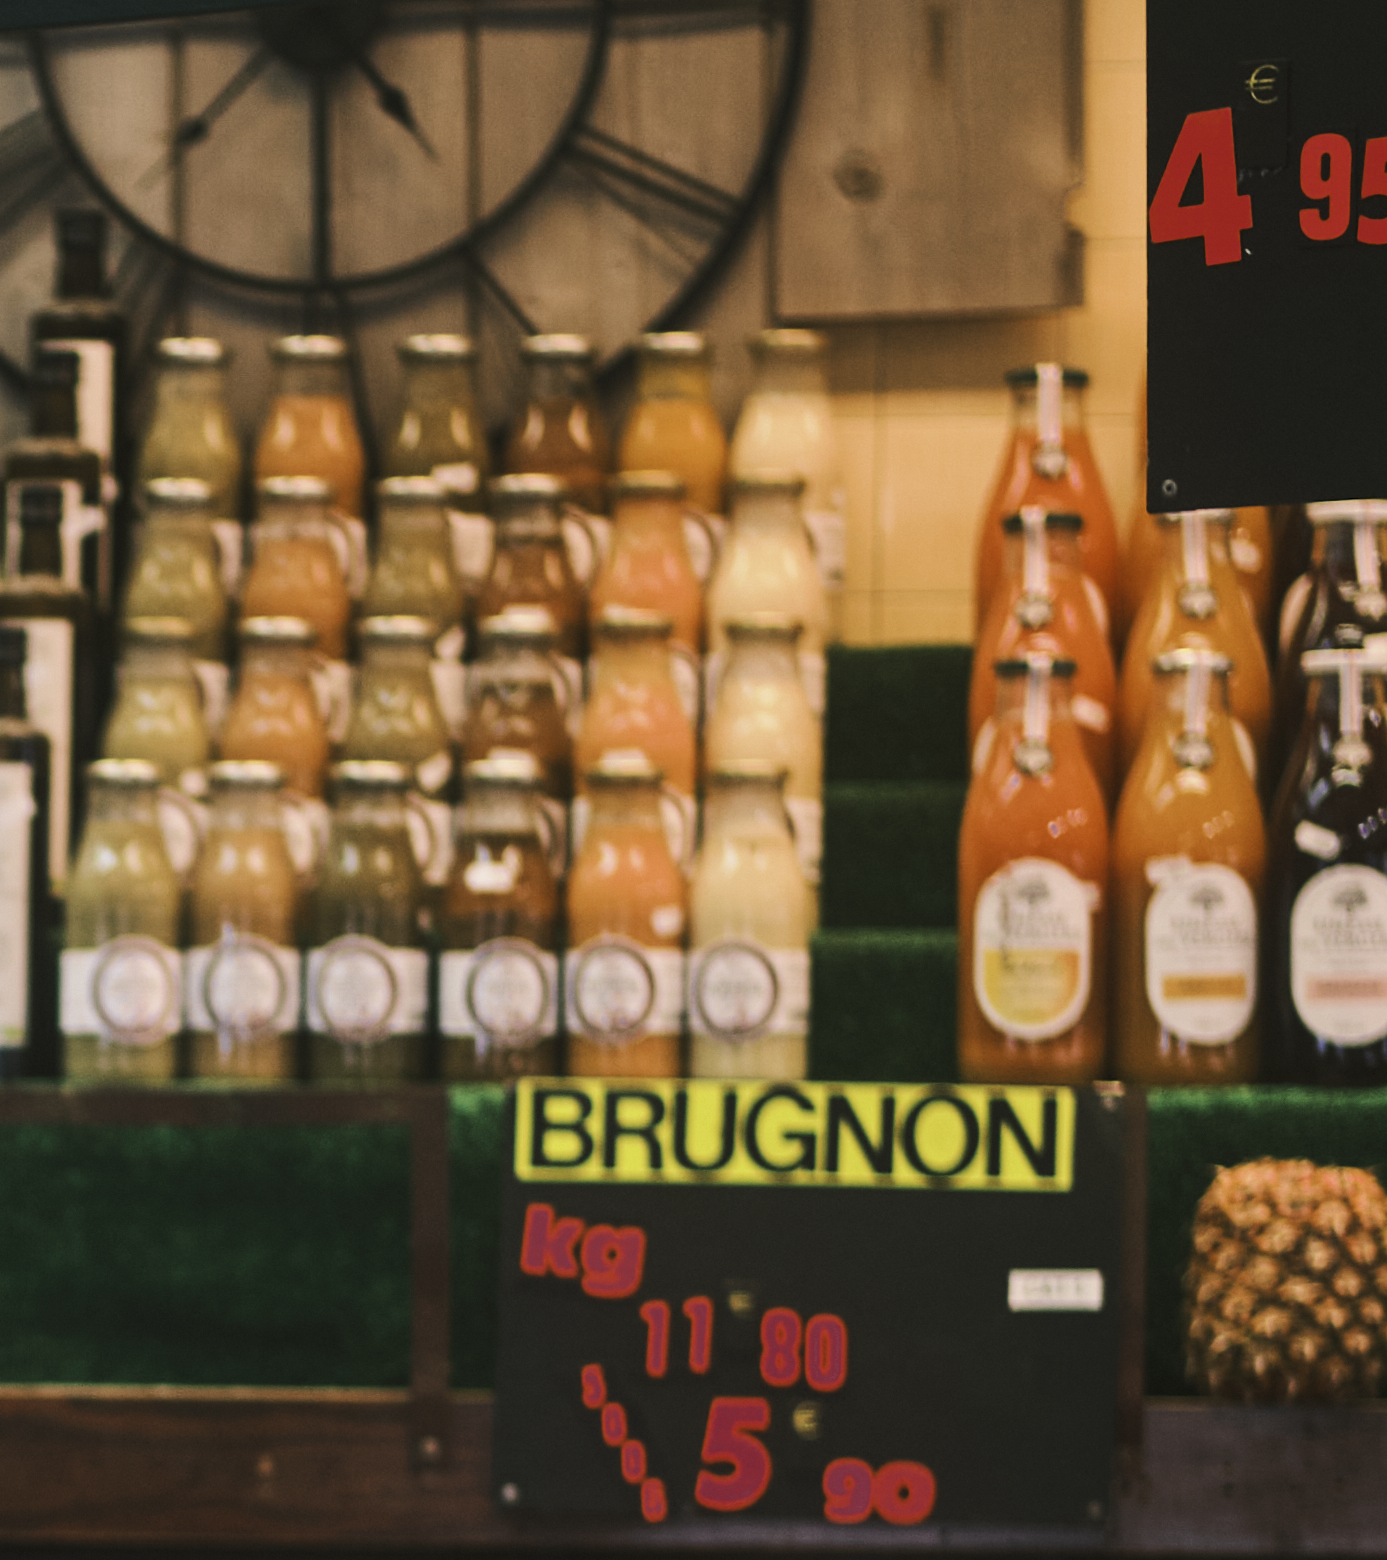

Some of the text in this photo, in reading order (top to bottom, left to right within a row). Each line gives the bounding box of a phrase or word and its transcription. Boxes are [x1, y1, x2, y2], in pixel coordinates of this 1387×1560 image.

[1148, 107, 1253, 266] 4
[530, 1085, 1059, 1178] BRUGNON
[520, 1202, 647, 1298] kg
